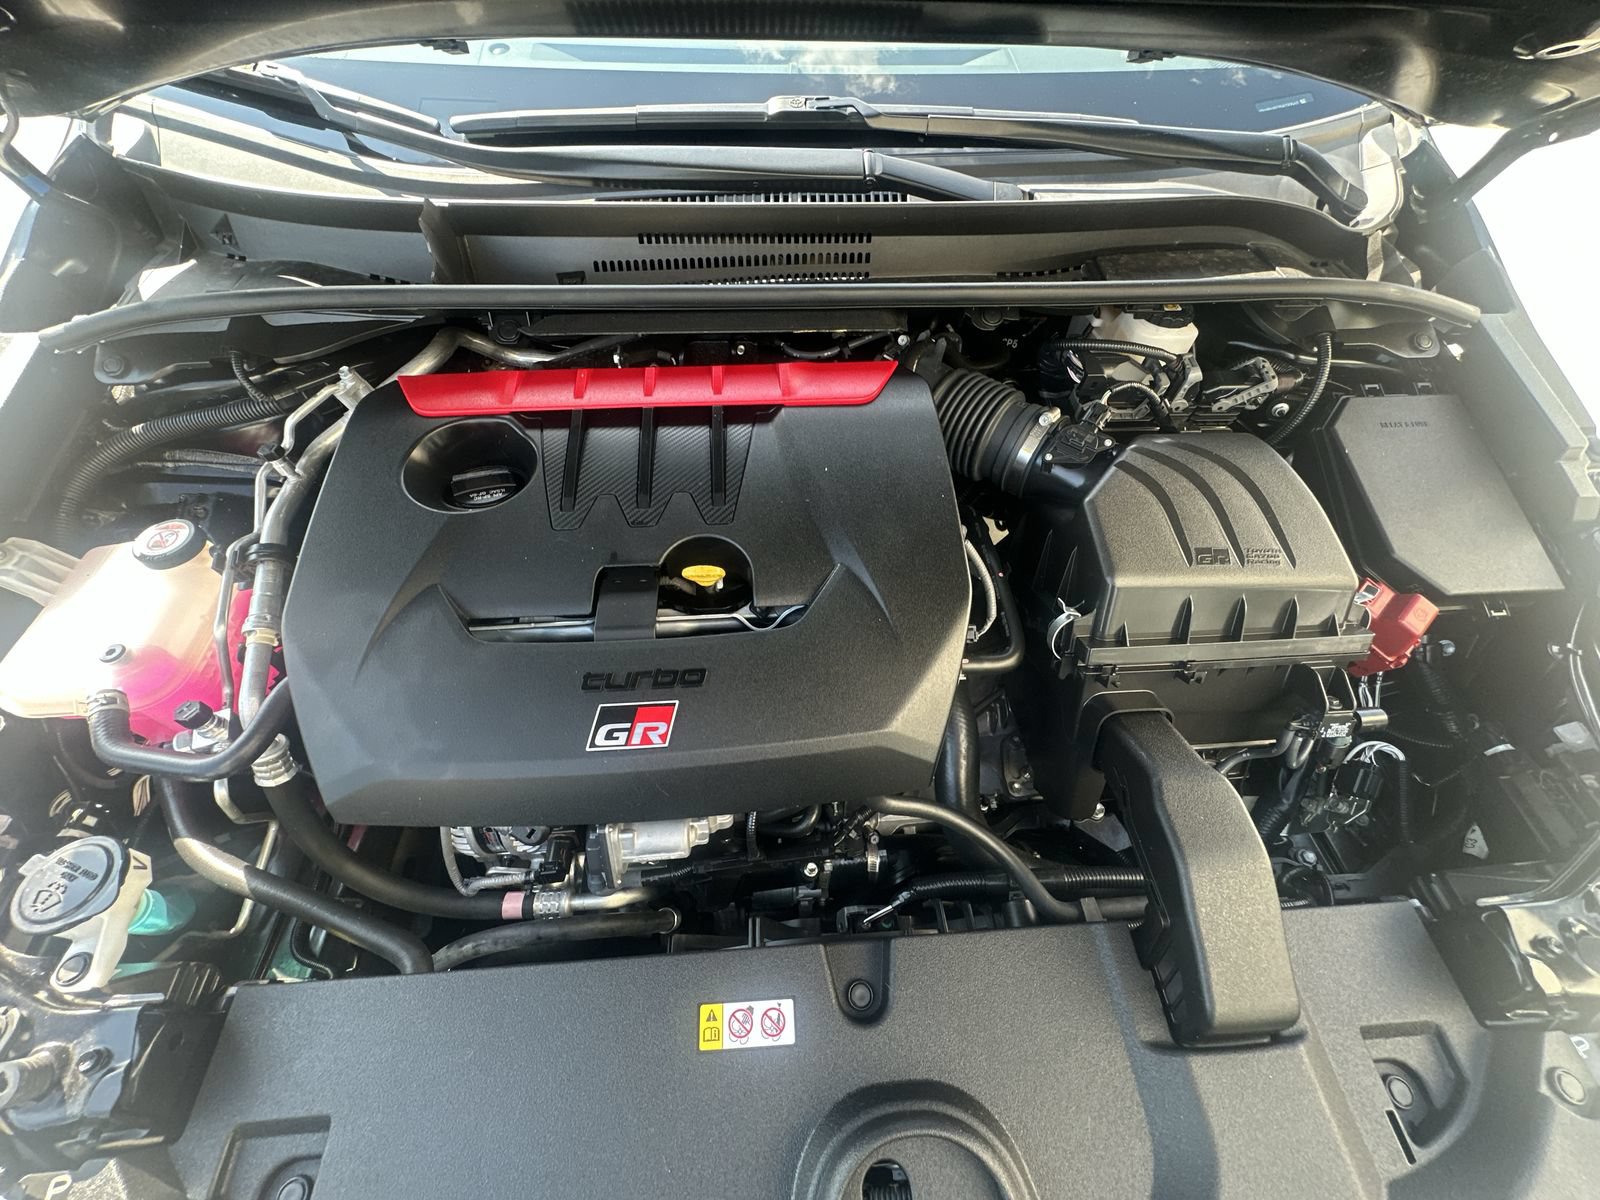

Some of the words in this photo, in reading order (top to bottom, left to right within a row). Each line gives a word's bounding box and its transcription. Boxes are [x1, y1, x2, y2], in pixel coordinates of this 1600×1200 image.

[1196, 551, 1231, 566] GR
[581, 668, 707, 690] turbo
[594, 721, 668, 746] GR
